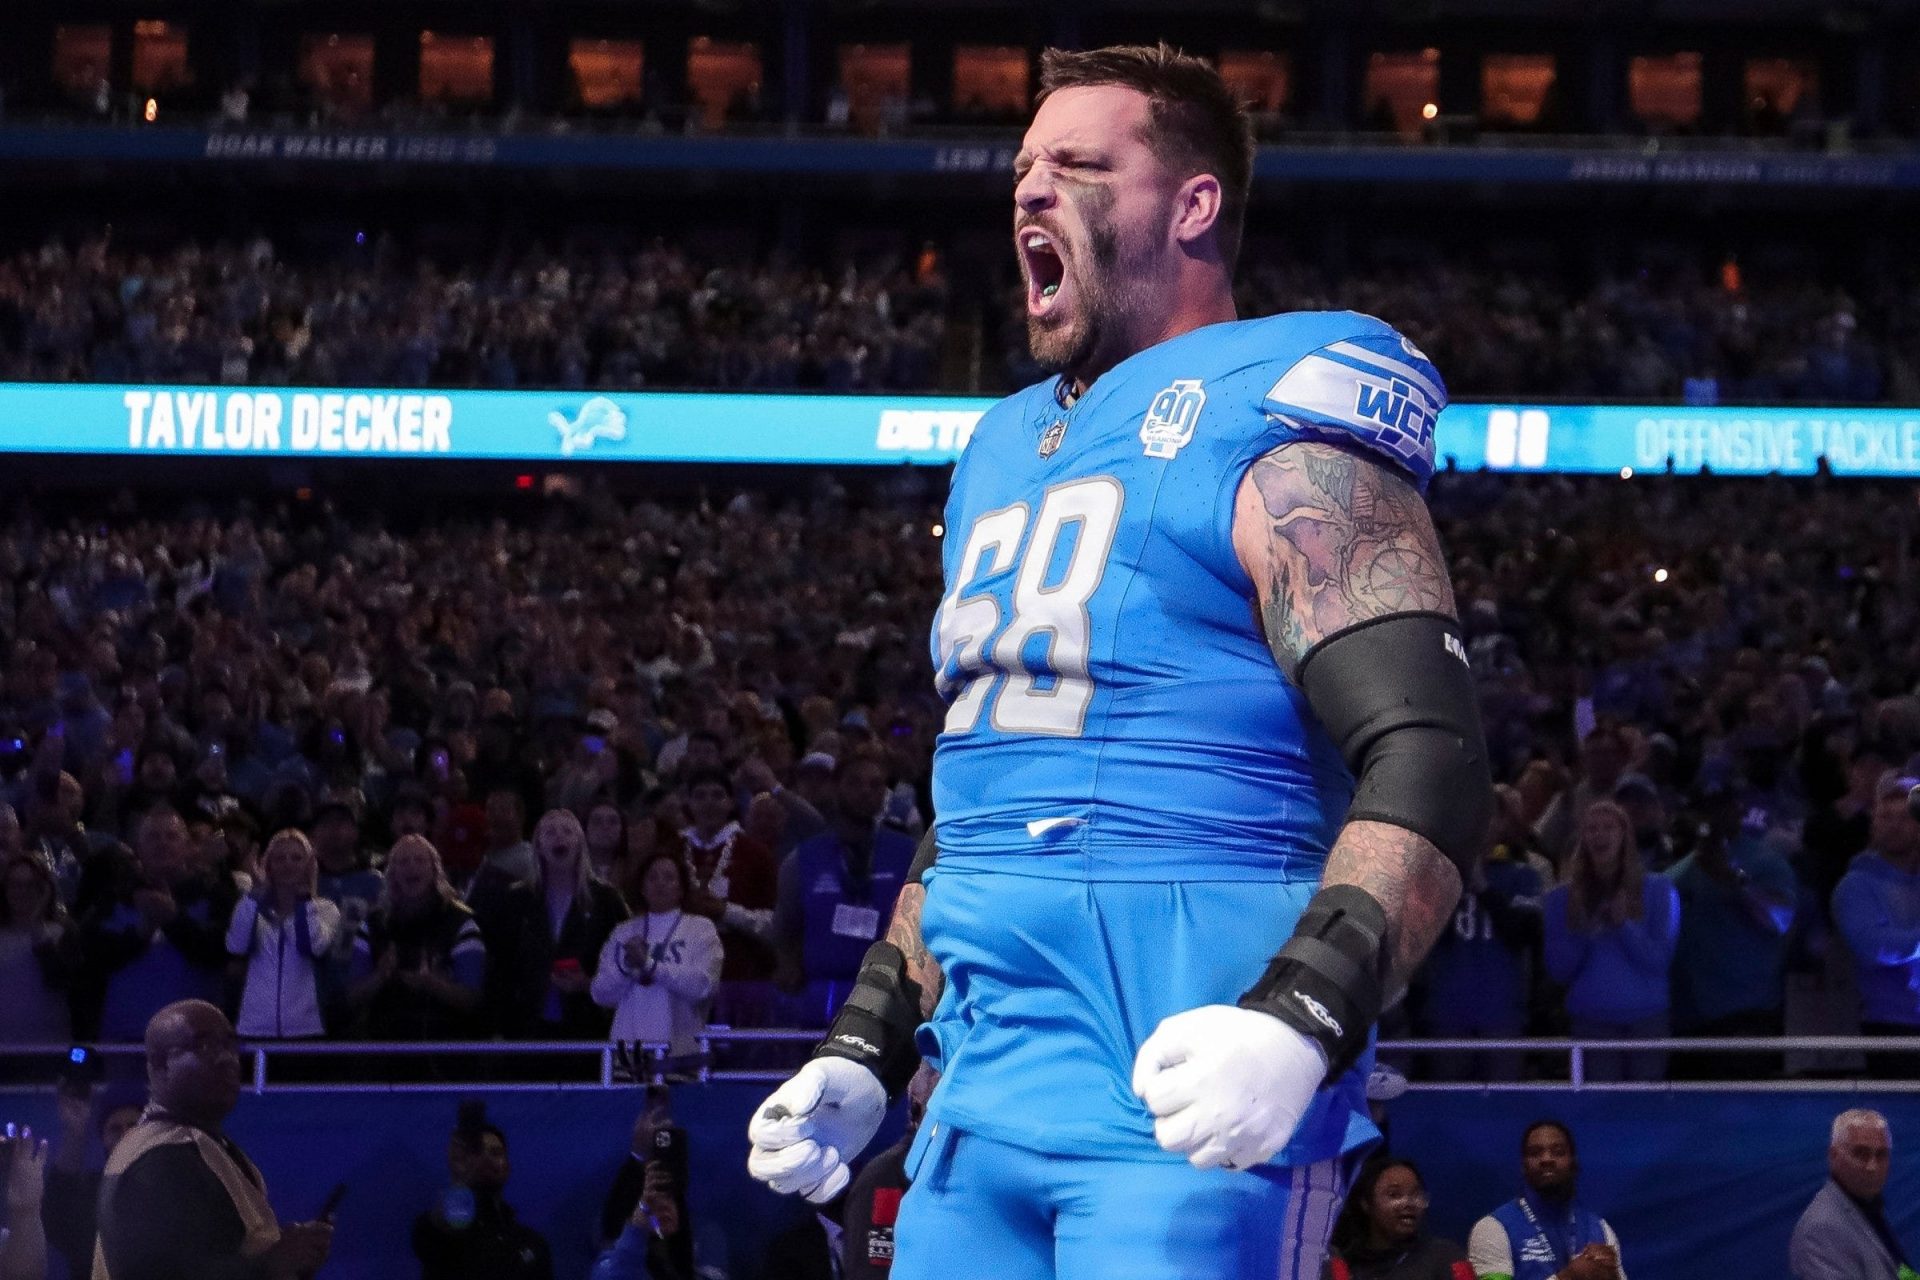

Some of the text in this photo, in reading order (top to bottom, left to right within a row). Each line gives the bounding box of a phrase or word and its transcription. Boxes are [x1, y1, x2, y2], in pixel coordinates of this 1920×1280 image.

[283, 134, 388, 160] WALKER
[124, 391, 452, 452] TAYLOR DECKER
[1150, 391, 1202, 437] 90
[1634, 418, 1920, 471] OFFENSIVE TACKLE
[936, 475, 1124, 737] 68
